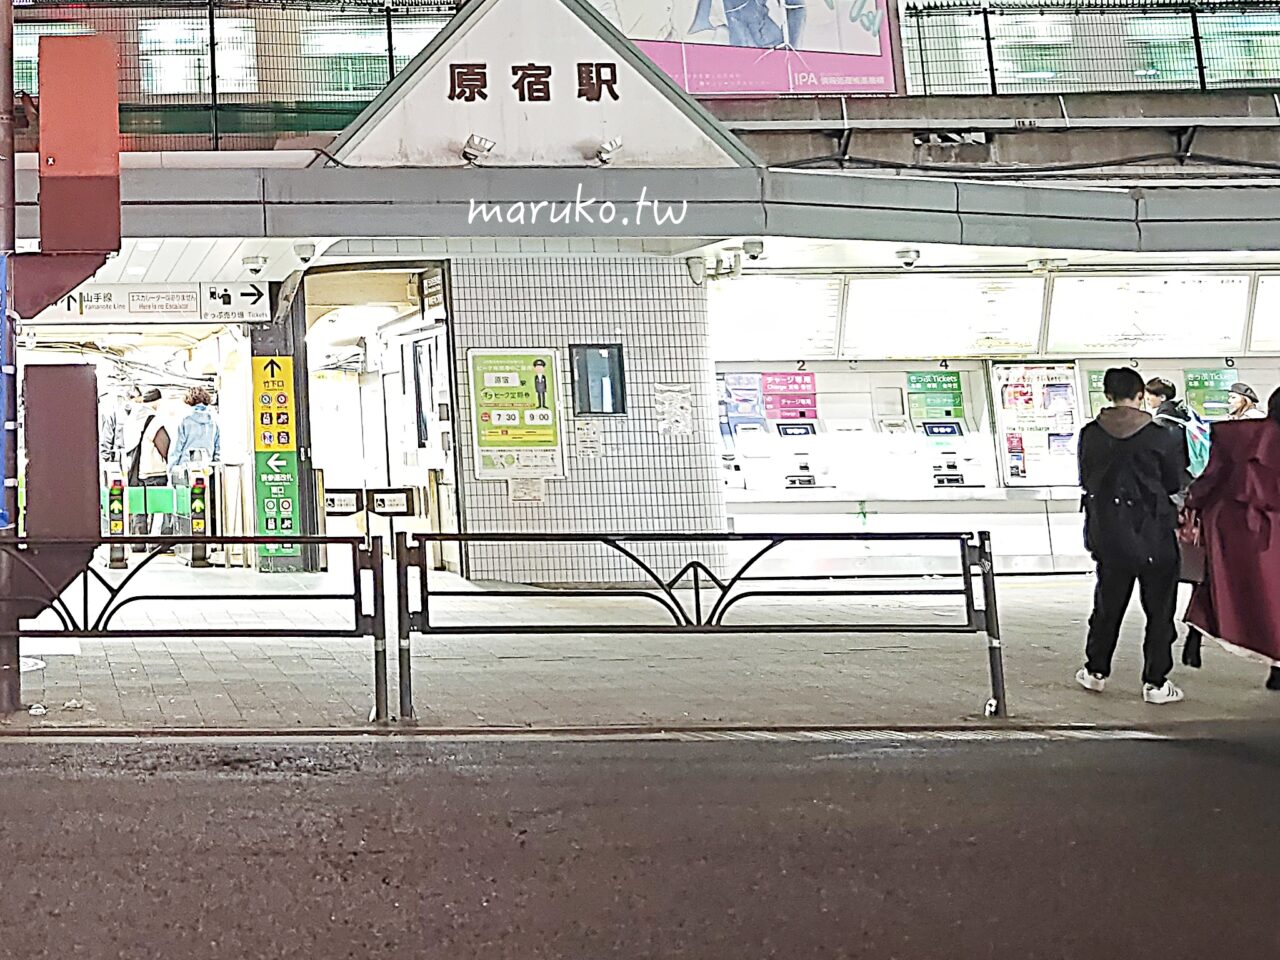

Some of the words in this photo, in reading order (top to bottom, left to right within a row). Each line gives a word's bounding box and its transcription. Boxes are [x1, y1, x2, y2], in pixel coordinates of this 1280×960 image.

[447, 62, 619, 102] 原宿駅
[794, 72, 819, 86] IPA
[84, 293, 112, 302] 山手線
[797, 360, 806, 371] 2
[939, 359, 949, 370] 4
[1225, 357, 1235, 367] 6
